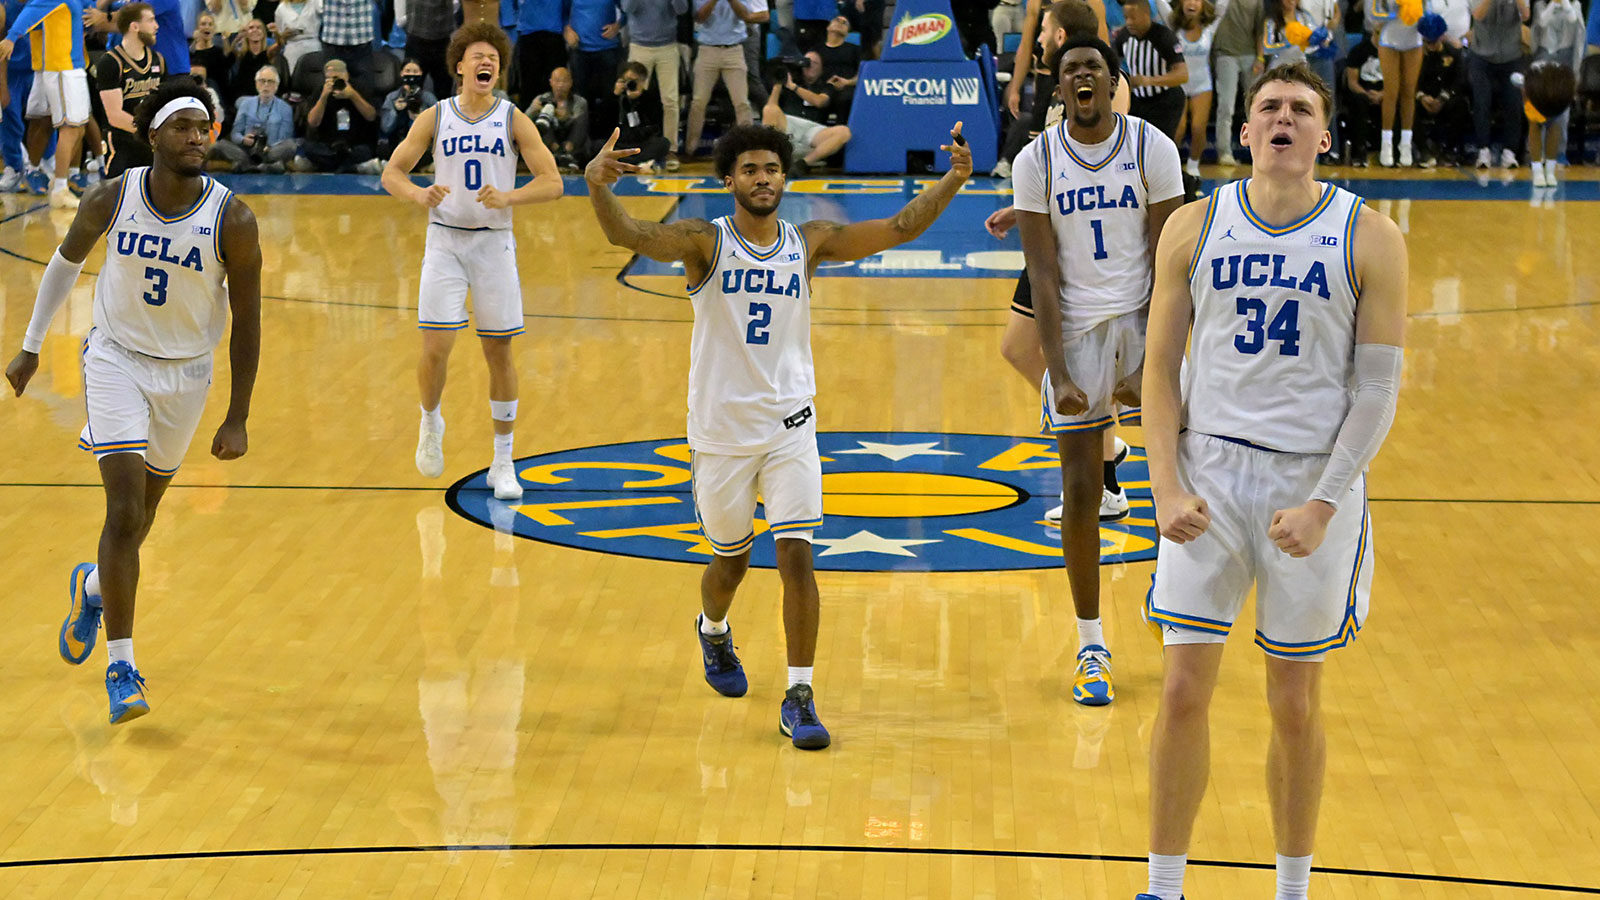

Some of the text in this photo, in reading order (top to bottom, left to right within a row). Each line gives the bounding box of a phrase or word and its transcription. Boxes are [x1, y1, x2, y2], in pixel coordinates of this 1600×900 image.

[891, 18, 946, 48] LIBMAN
[864, 79, 946, 97] WESCOM
[903, 96, 947, 105] Financial
[442, 134, 505, 158] UCLA
[464, 159, 482, 190] 0
[1056, 185, 1139, 216] UCLA
[117, 231, 204, 272] UCLA
[1090, 220, 1108, 260] 1
[143, 267, 169, 306] 3
[722, 269, 801, 299] UCLA
[1211, 253, 1331, 301] UCLA
[746, 302, 772, 345] 2
[1233, 297, 1300, 356] 34
